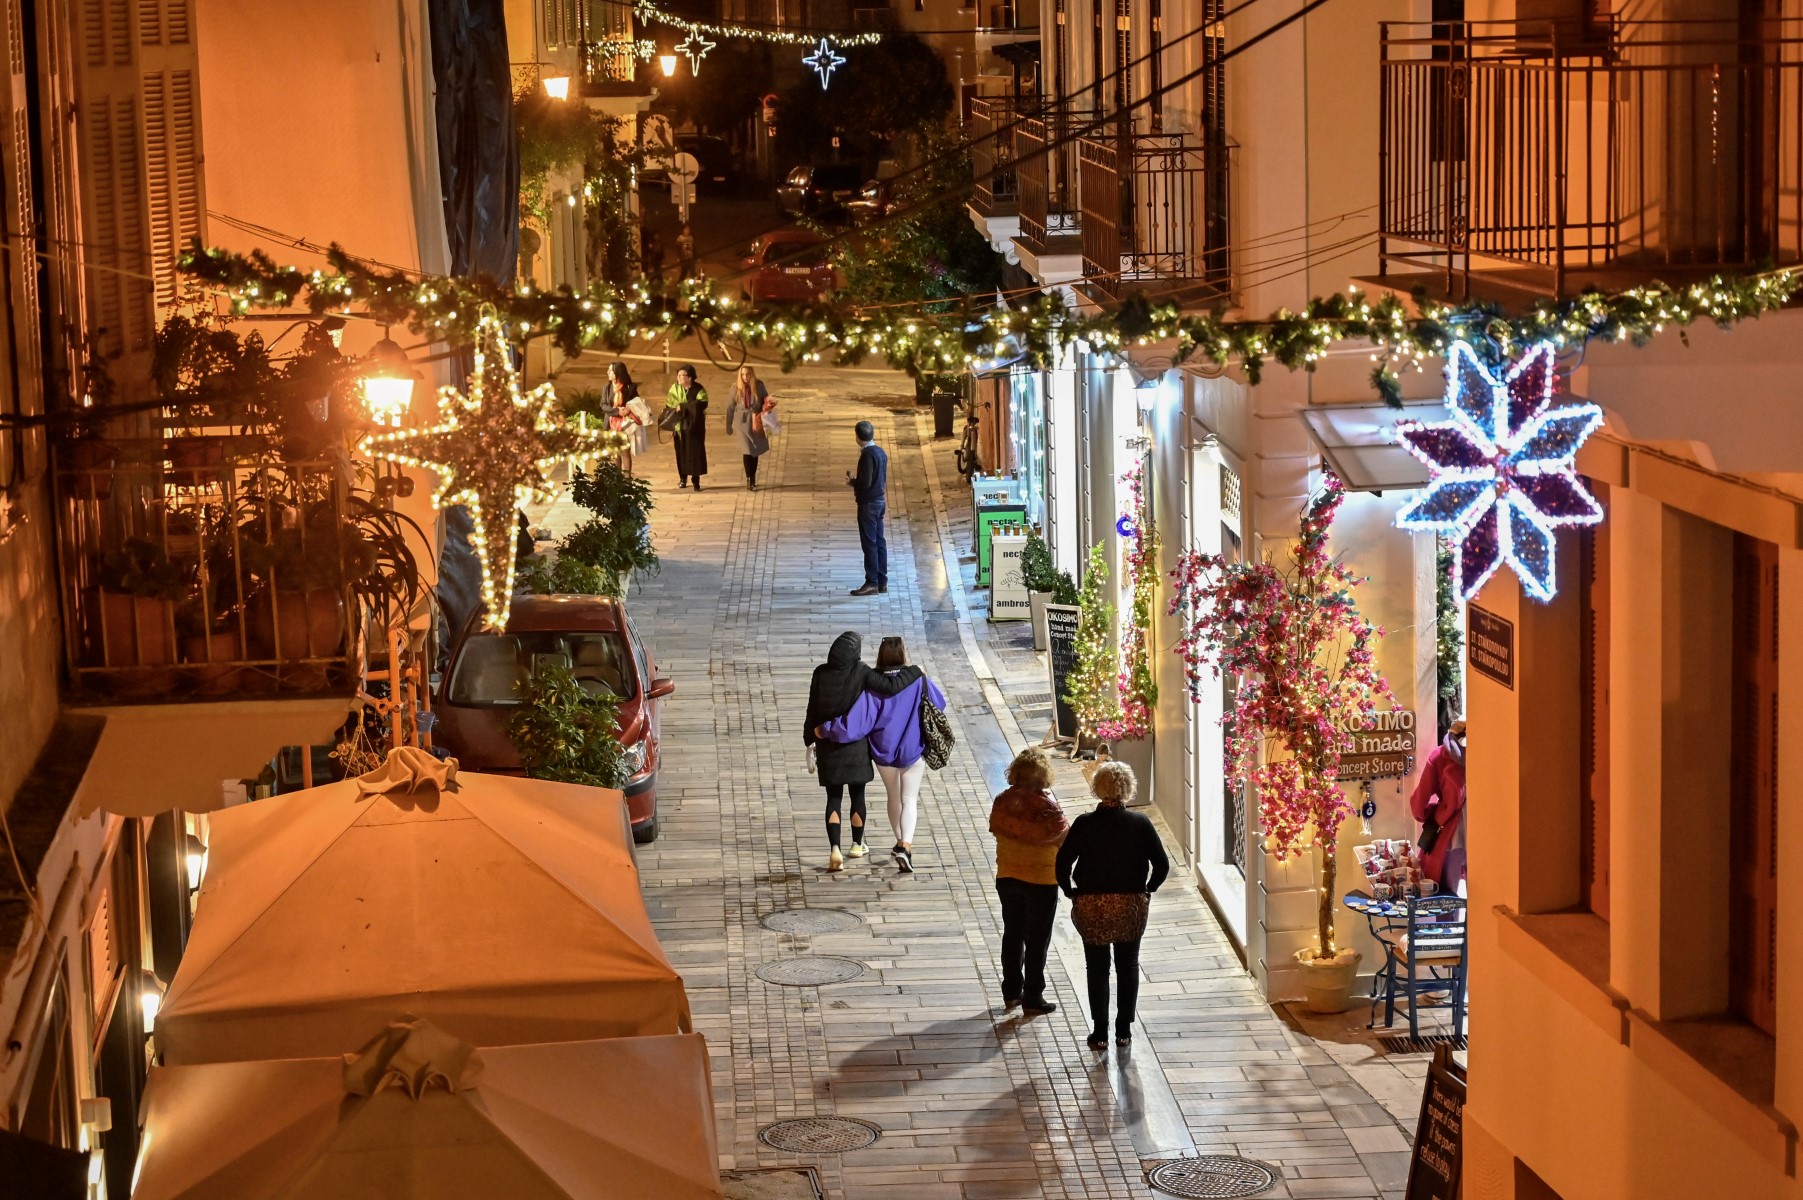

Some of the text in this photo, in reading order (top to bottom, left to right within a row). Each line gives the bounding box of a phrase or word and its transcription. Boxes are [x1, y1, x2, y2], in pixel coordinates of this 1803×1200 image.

[1065, 624, 1078, 632] mad
[1328, 734, 1413, 754] and made
[1336, 757, 1404, 775] oncept Store
[1443, 1096, 1457, 1113] would
[1420, 1143, 1436, 1165] refuse
